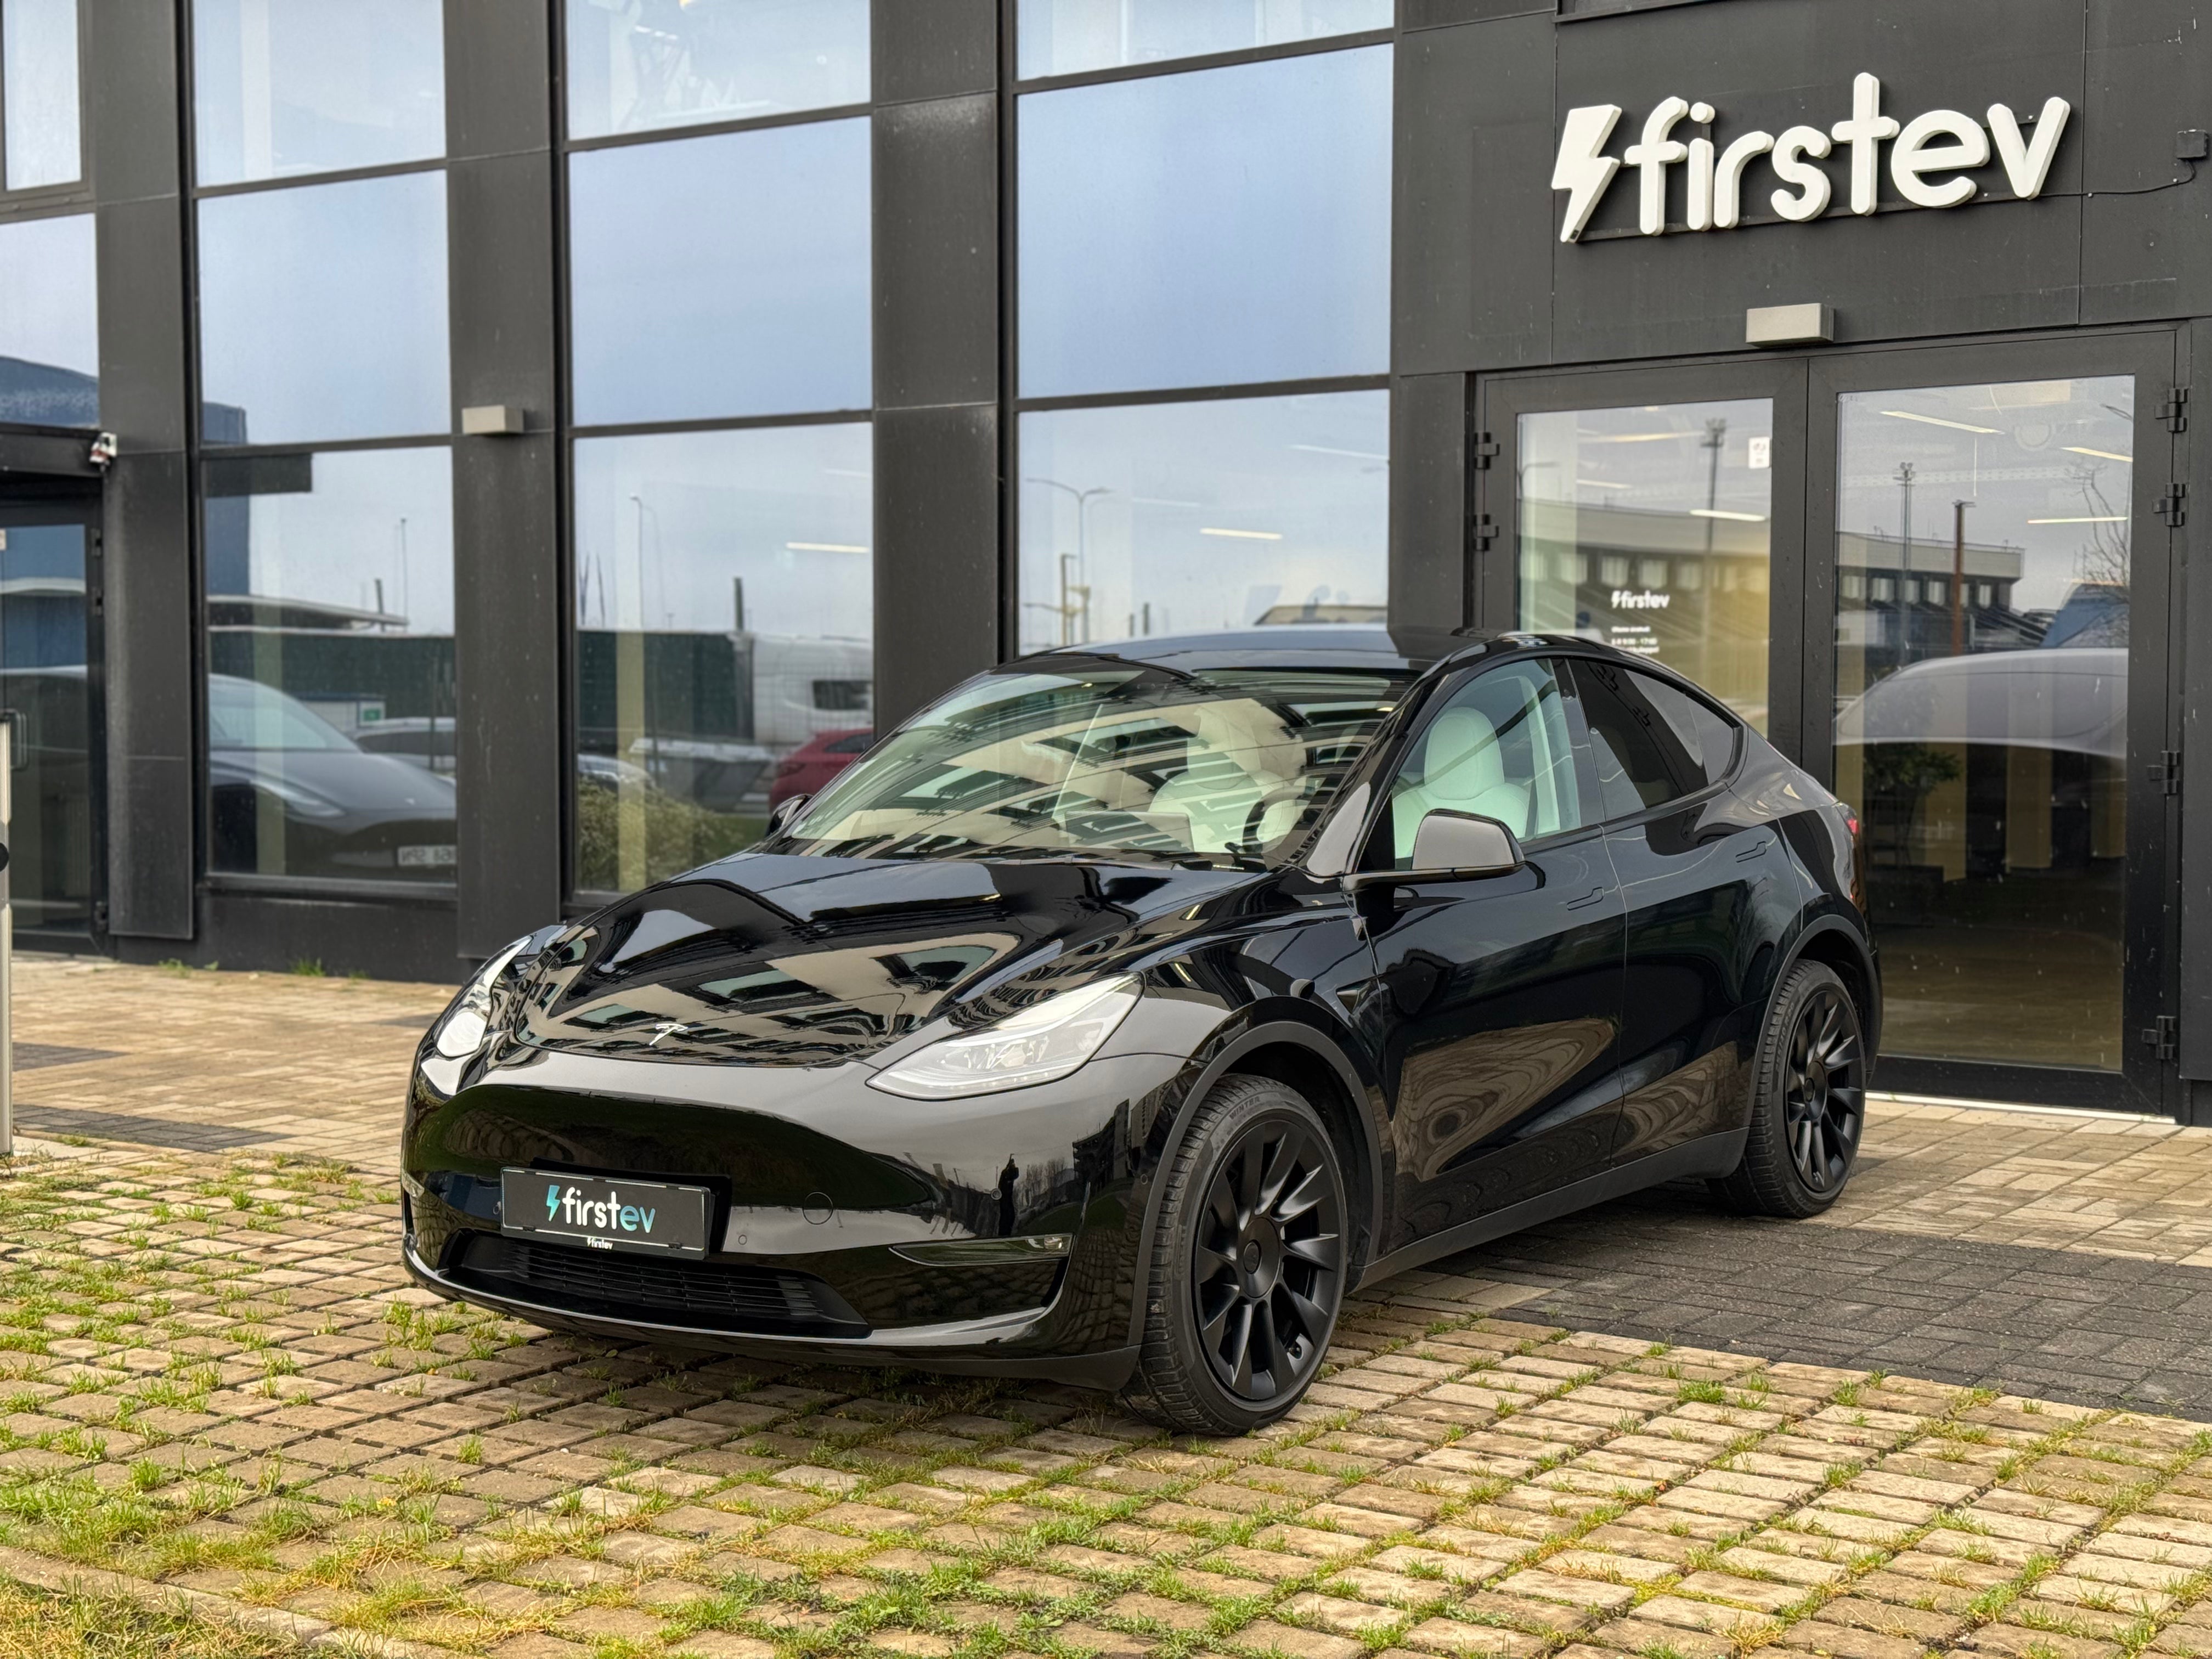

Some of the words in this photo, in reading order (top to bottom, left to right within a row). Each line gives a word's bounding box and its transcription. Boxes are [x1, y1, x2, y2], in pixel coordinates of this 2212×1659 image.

[1624, 72, 2070, 236] firstev
[1621, 590, 1670, 608] firstev
[1229, 1096, 1261, 1120] WINTER
[562, 1187, 656, 1233] firstev
[591, 1237, 613, 1250] firstev
